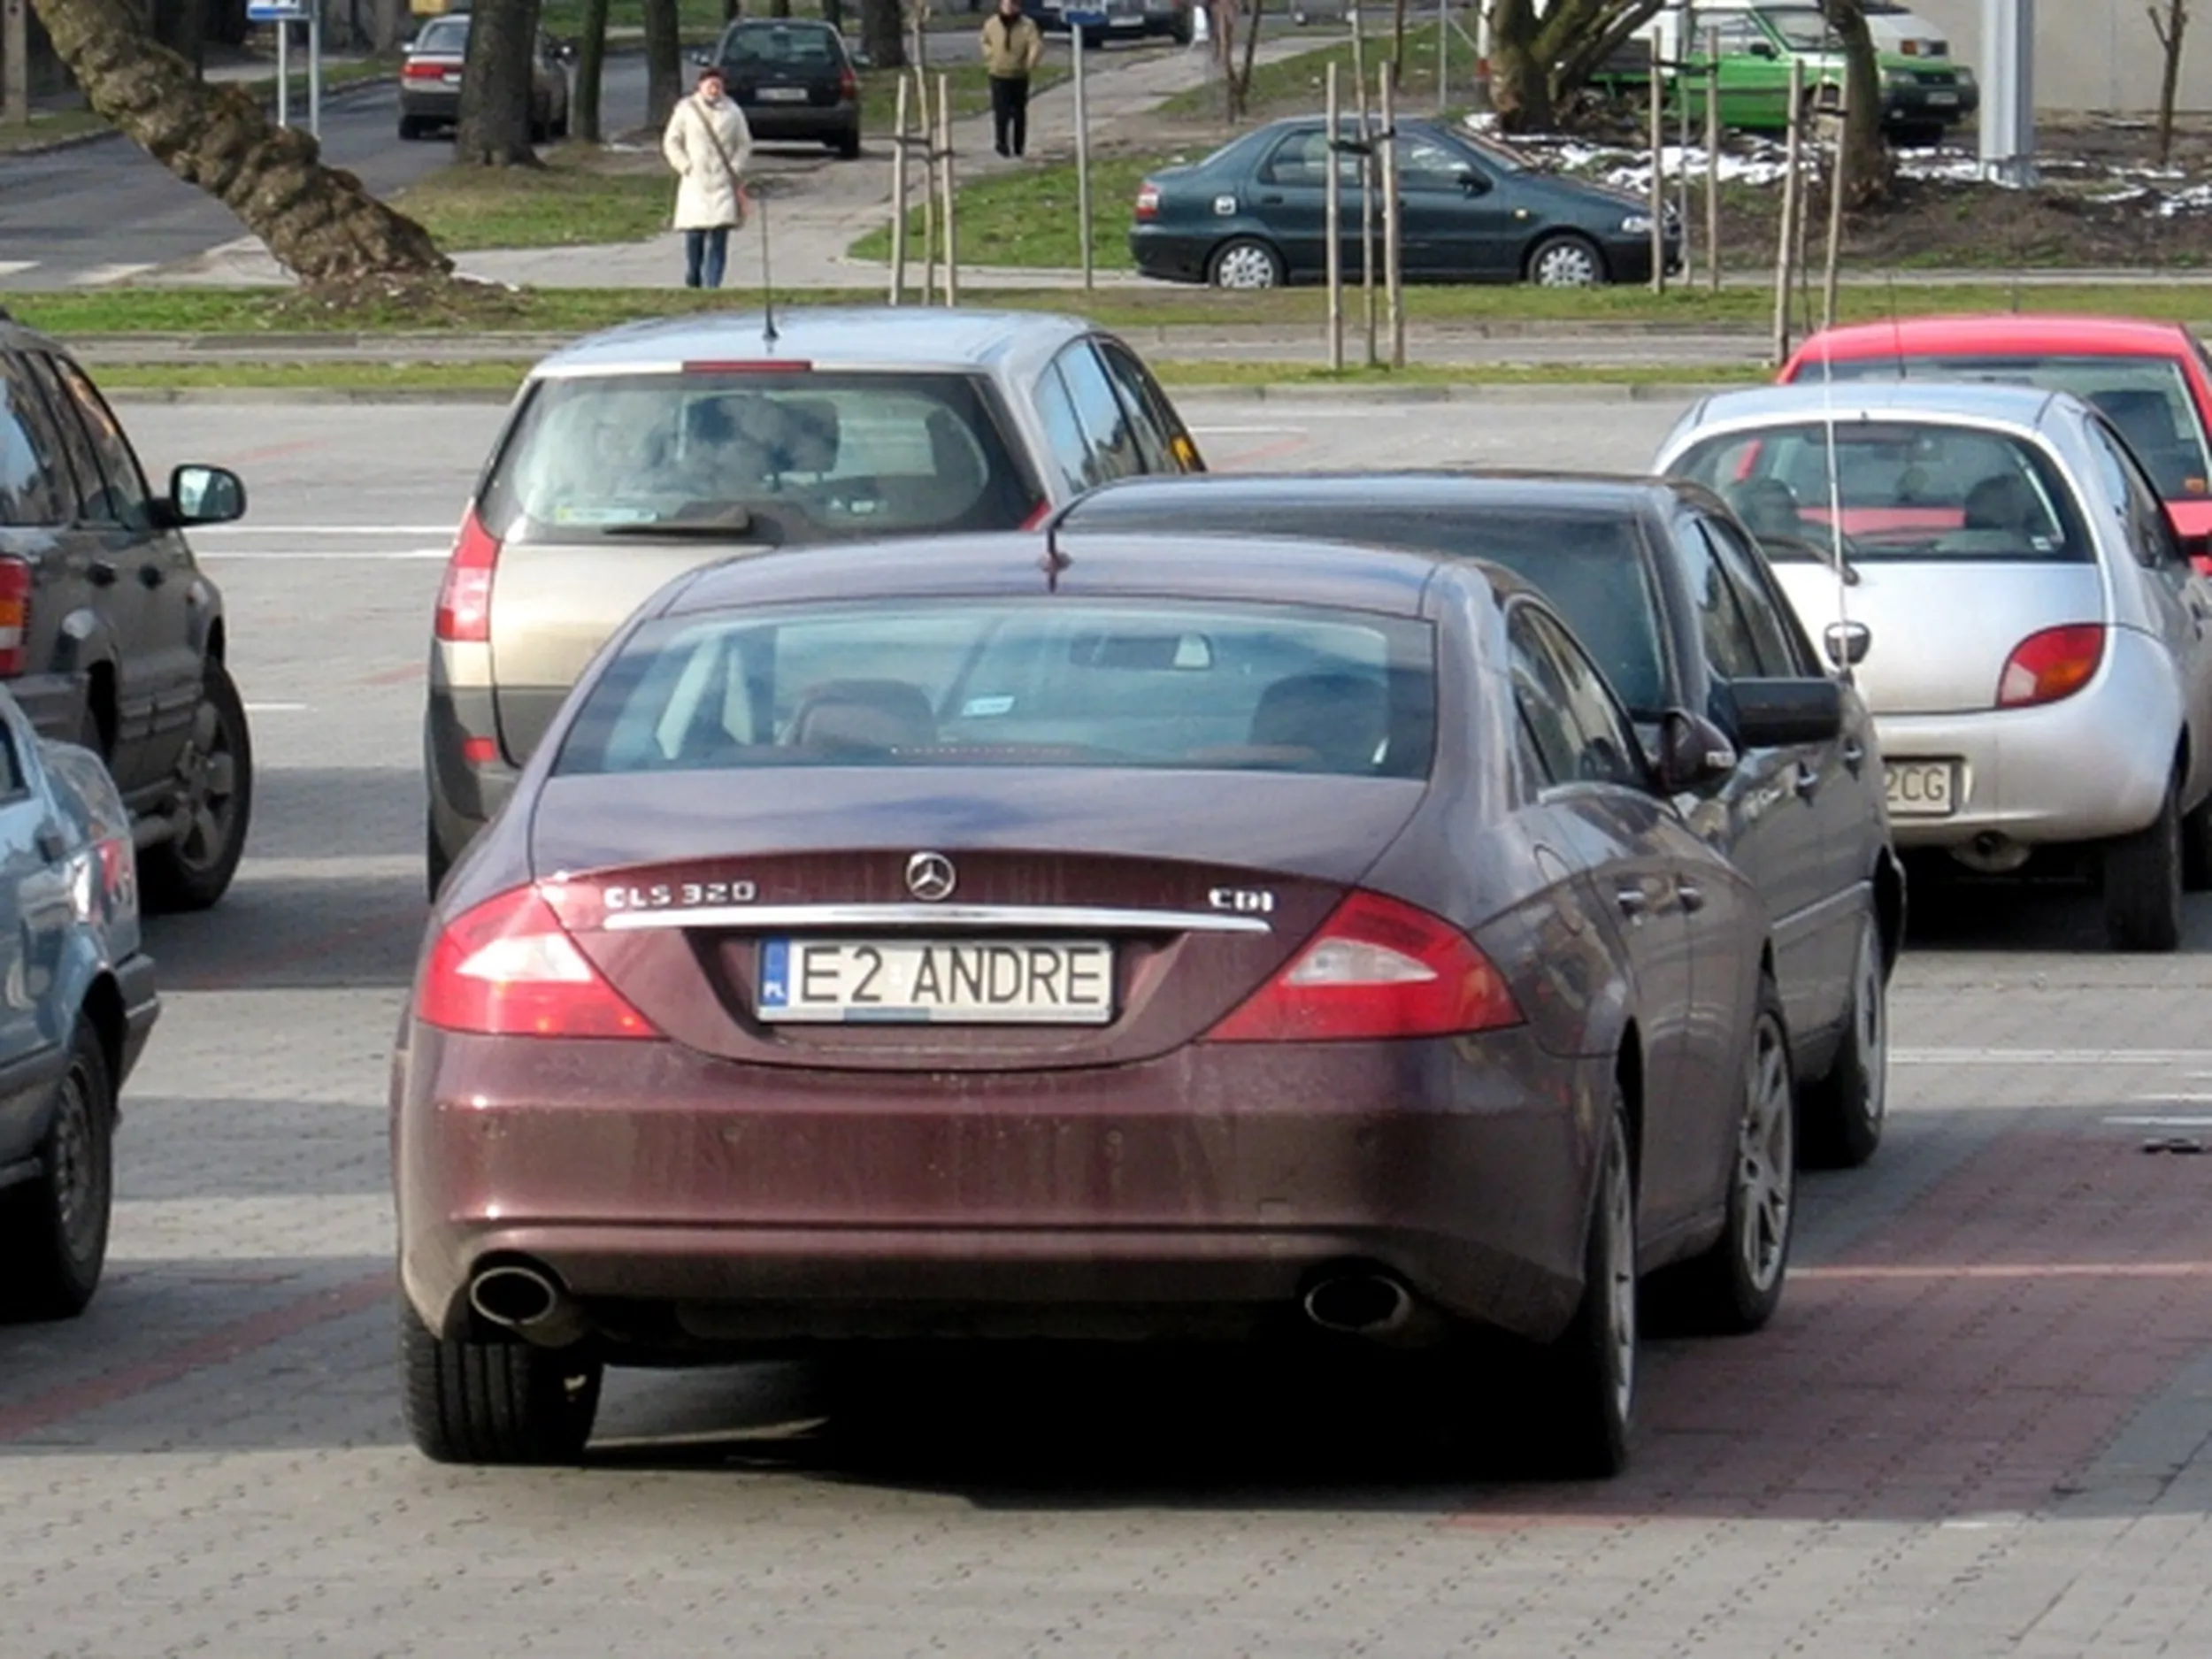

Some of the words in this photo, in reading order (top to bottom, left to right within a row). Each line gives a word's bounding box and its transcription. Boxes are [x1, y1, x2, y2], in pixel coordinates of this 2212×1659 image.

[603, 885, 672, 909] CLS
[681, 880, 757, 904] 320
[1209, 887, 1274, 913] CDI
[801, 946, 883, 1003] E2
[910, 947, 1101, 1003] ANDRE
